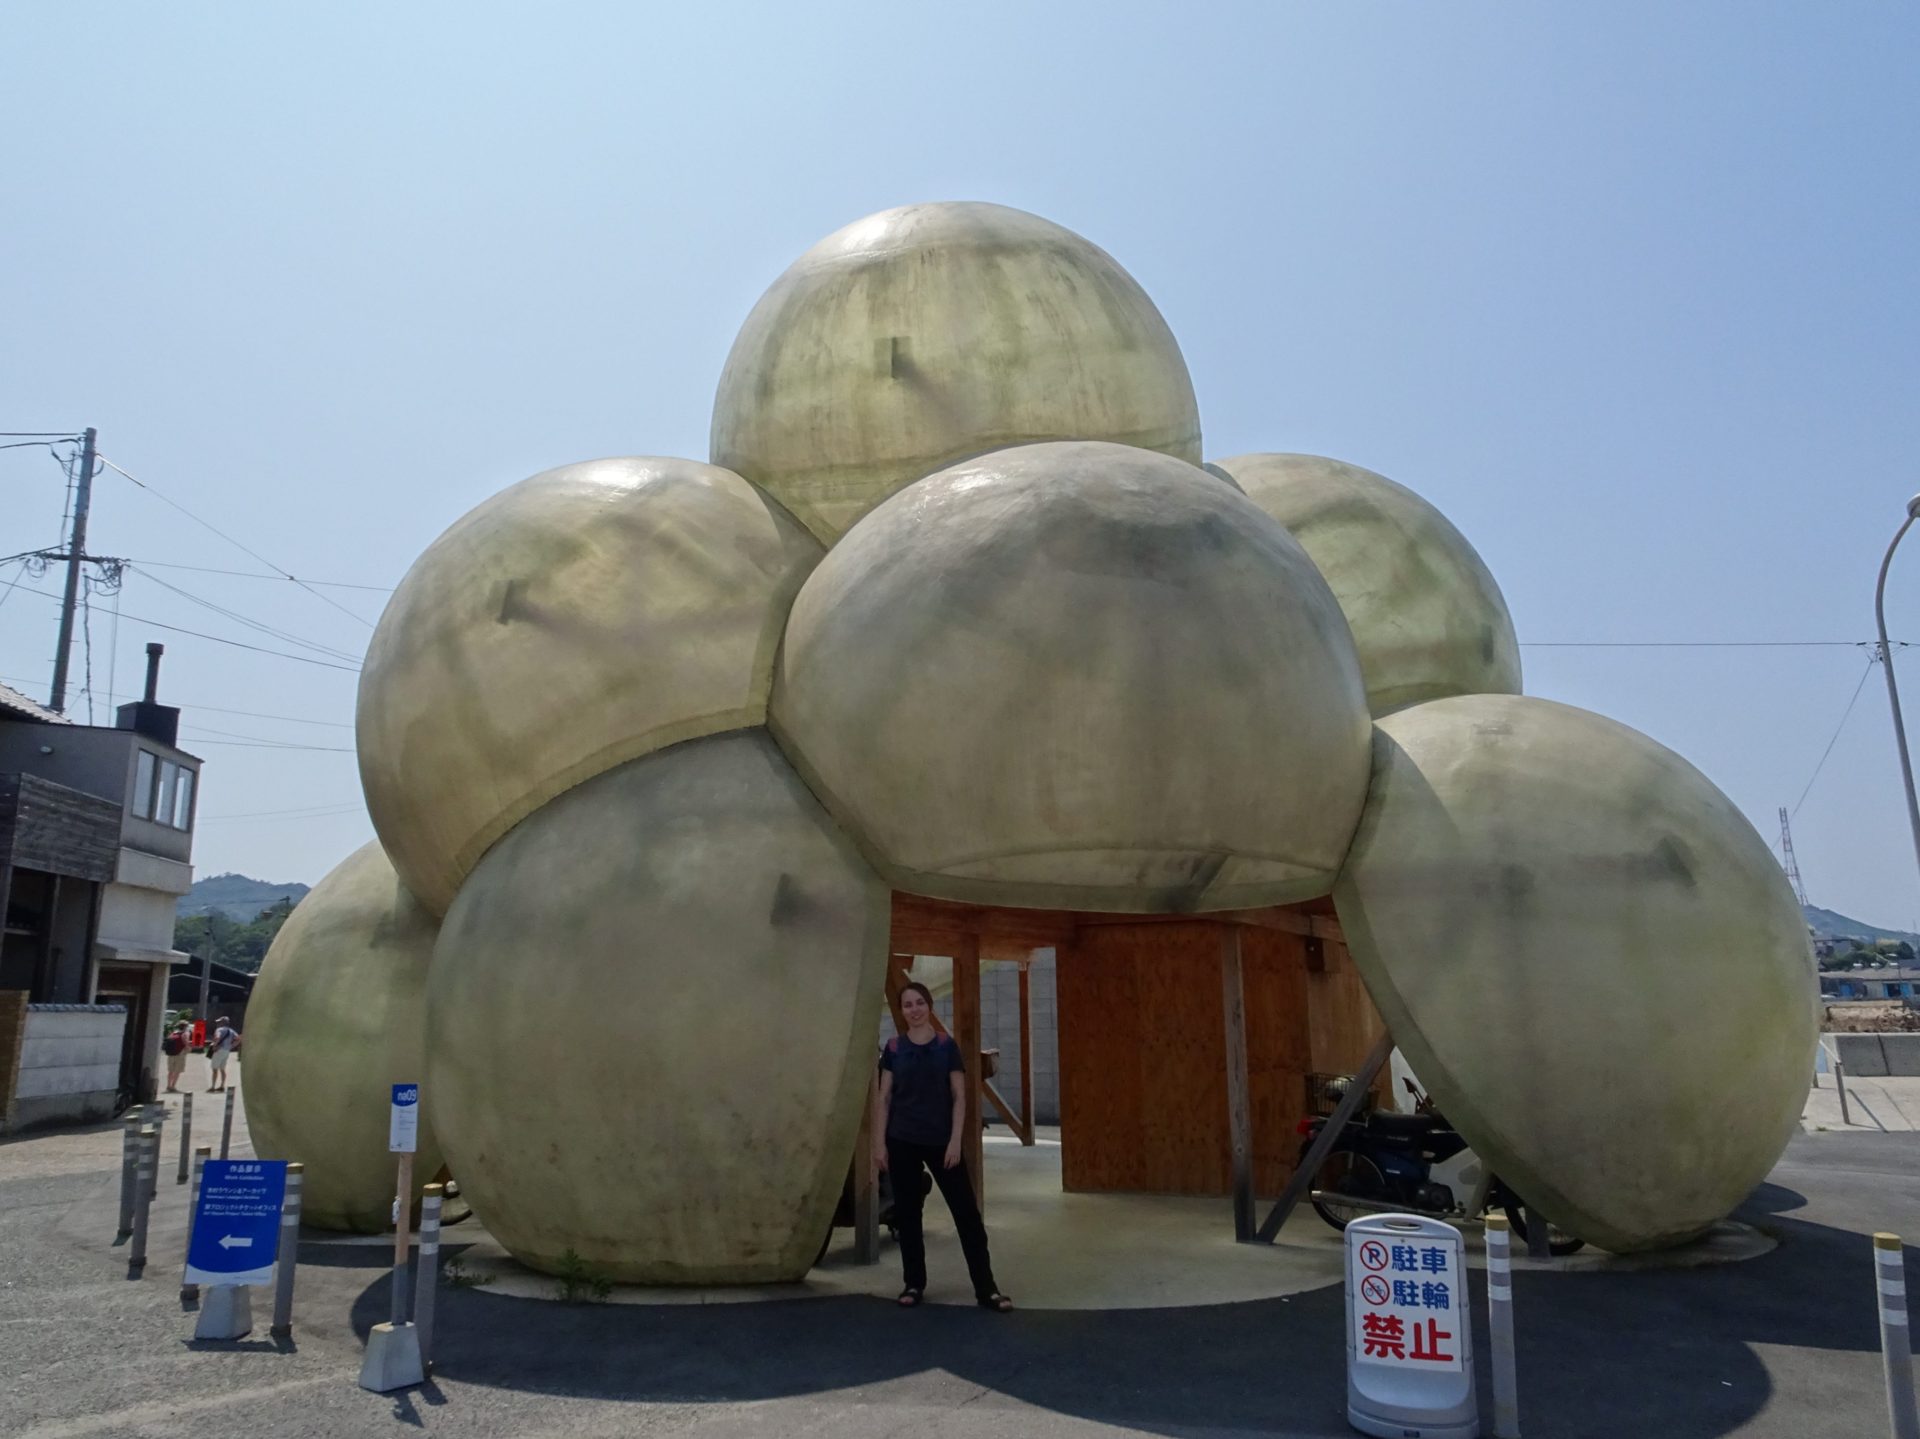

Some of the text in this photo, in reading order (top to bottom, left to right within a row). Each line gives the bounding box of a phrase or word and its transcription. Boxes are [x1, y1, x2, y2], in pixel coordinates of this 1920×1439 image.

[1391, 1245, 1448, 1275] 駐車
[1393, 1280, 1450, 1310] 駐輪
[1362, 1312, 1454, 1362] 禁止
